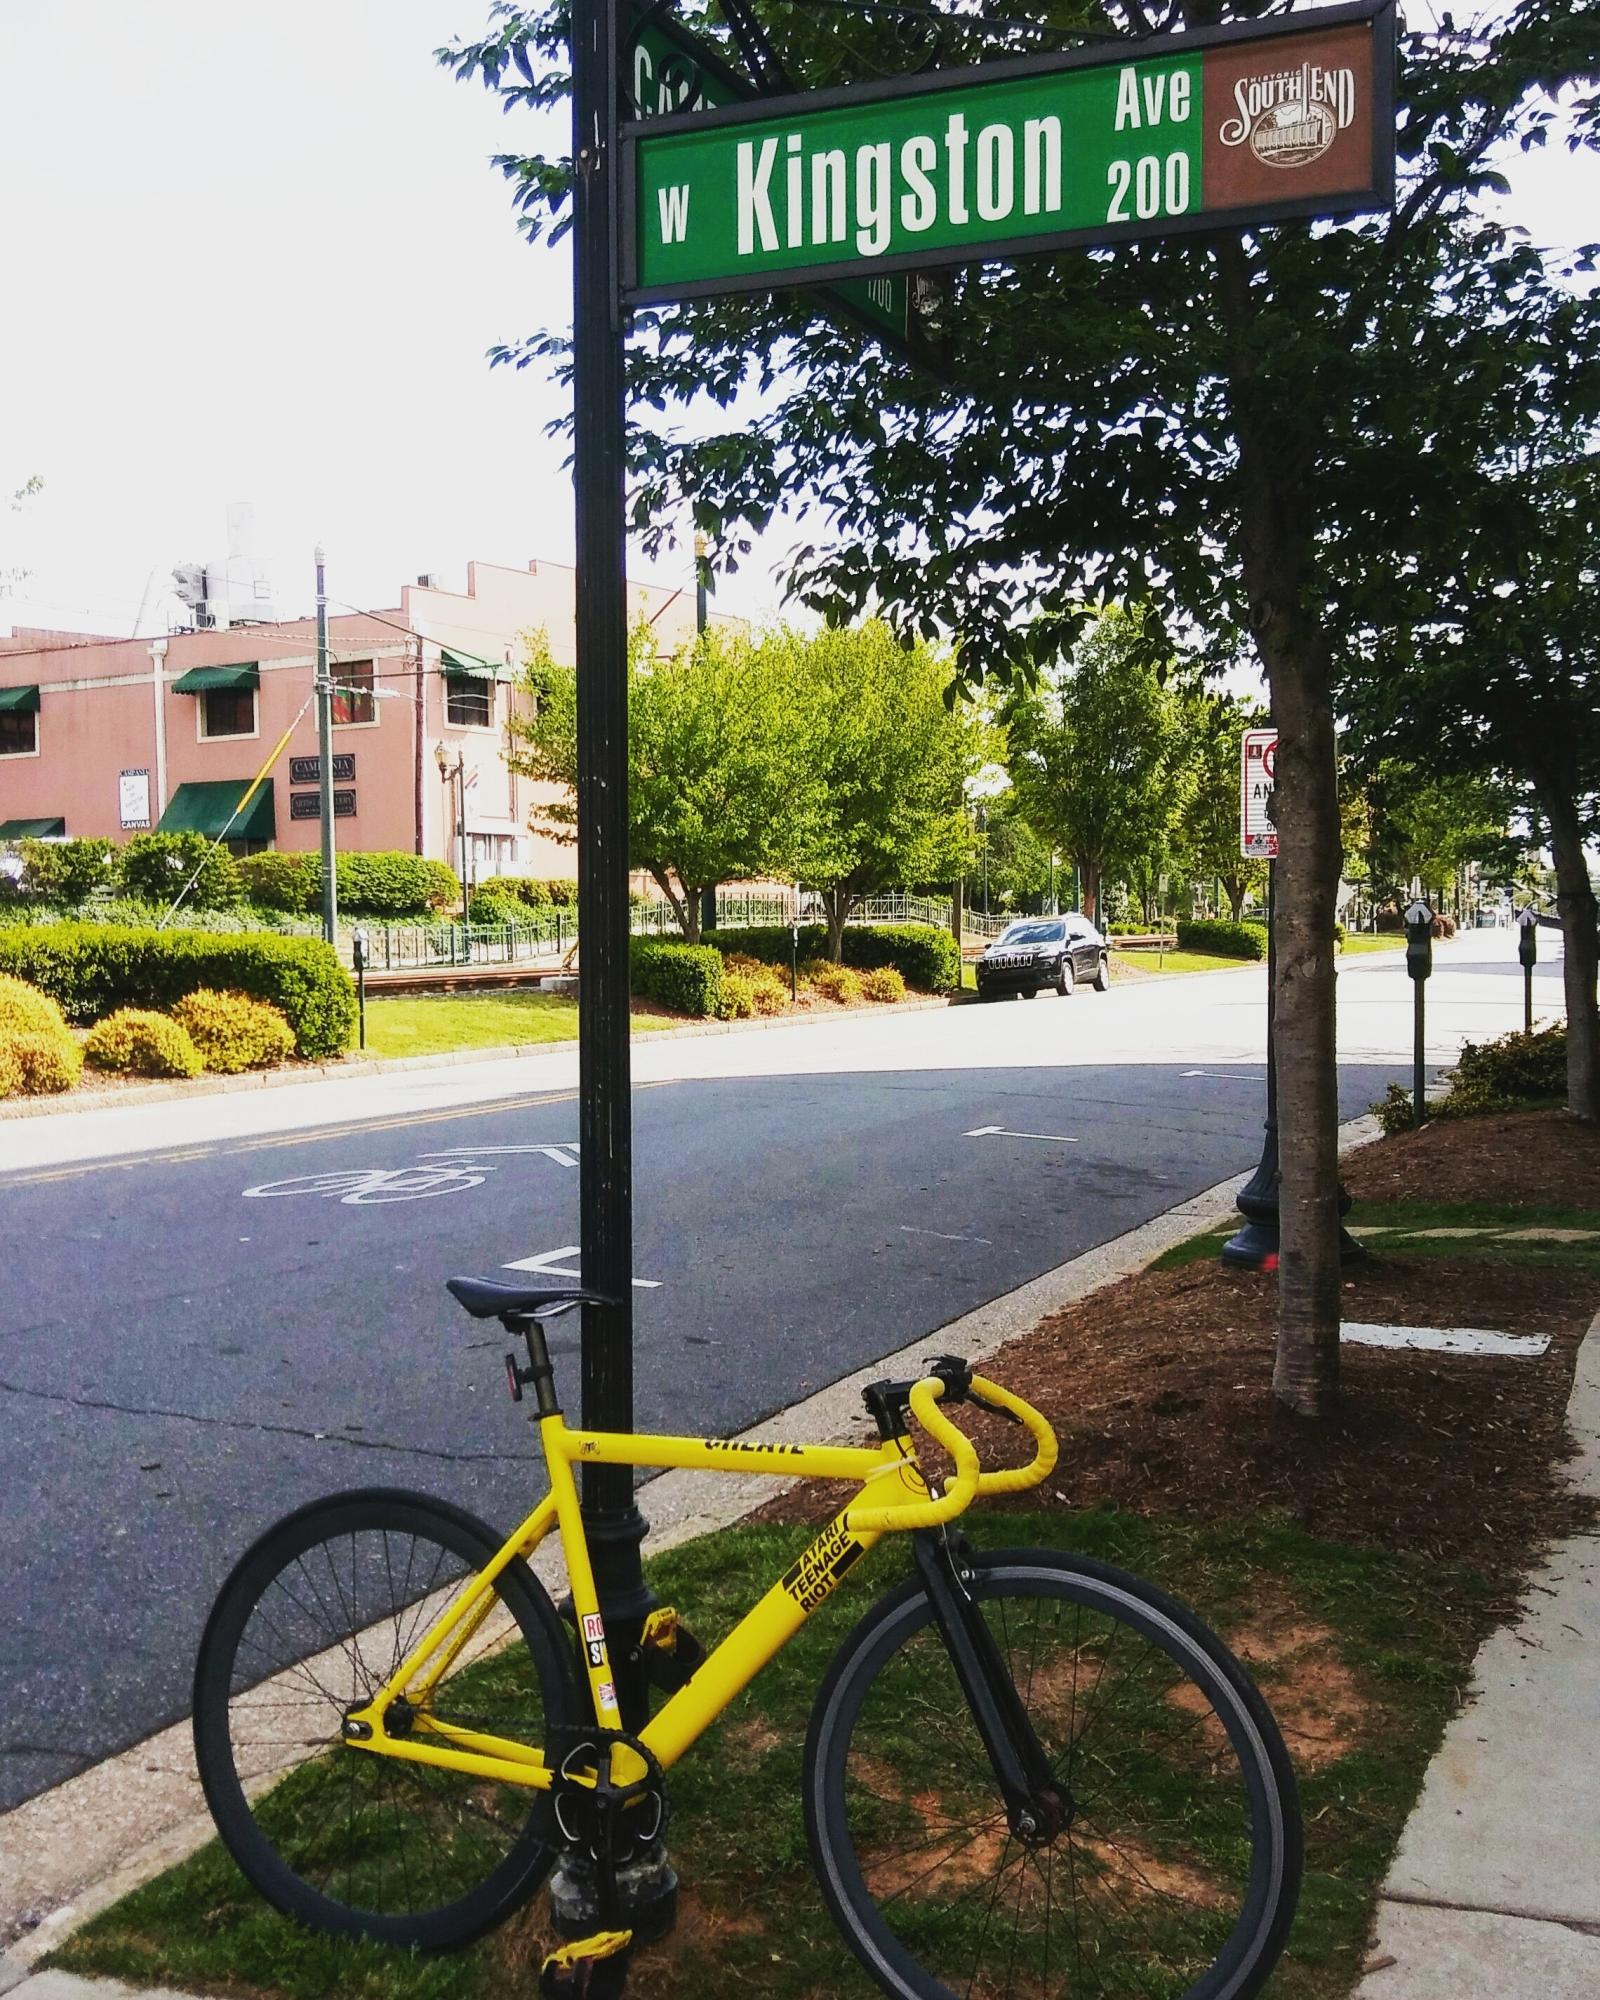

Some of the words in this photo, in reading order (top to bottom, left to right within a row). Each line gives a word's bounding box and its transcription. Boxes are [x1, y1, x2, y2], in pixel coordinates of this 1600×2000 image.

[1220, 75, 1302, 146] SOUTH
[1310, 66, 1355, 129] END
[1250, 70, 1301, 83] HISTORIC
[659, 185, 690, 244] W
[738, 113, 1062, 256] Kingston
[1115, 67, 1190, 131] Ave
[1107, 151, 1190, 223] 200
[121, 821, 151, 830] CANVAS
[788, 1530, 851, 1602] TEENAGE
[803, 1519, 839, 1569] ATARI
[800, 1573, 834, 1613] RIOT
